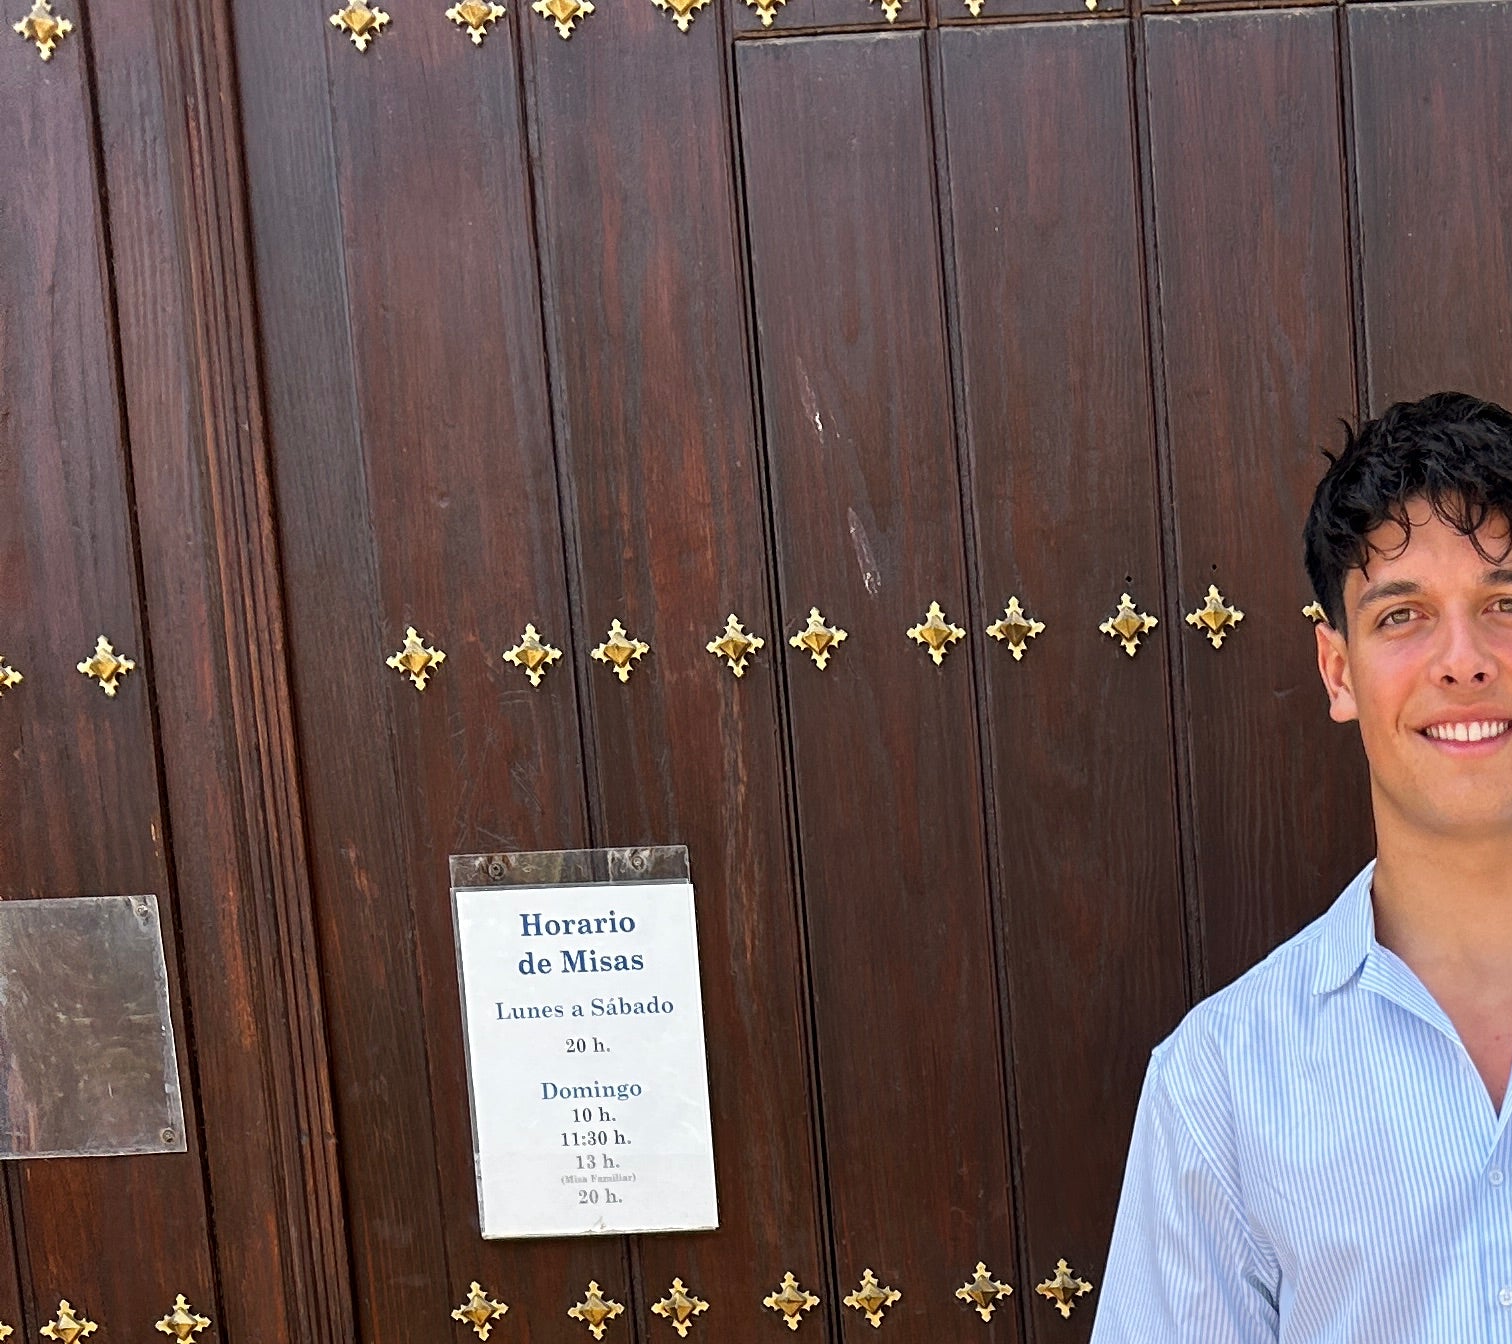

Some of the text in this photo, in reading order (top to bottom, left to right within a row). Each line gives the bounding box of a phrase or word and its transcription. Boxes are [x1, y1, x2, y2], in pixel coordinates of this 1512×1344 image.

[520, 910, 635, 936] Horario
[519, 950, 643, 975] de Misas
[495, 996, 673, 1021] Lunes a Sábado
[566, 1037, 610, 1053] 20 h.
[541, 1081, 641, 1101] Domingo
[573, 1107, 616, 1122] 10 h.
[561, 1130, 631, 1146] 11:30 h.
[576, 1154, 620, 1169] 13 h.
[579, 1188, 622, 1204] 20 h.
